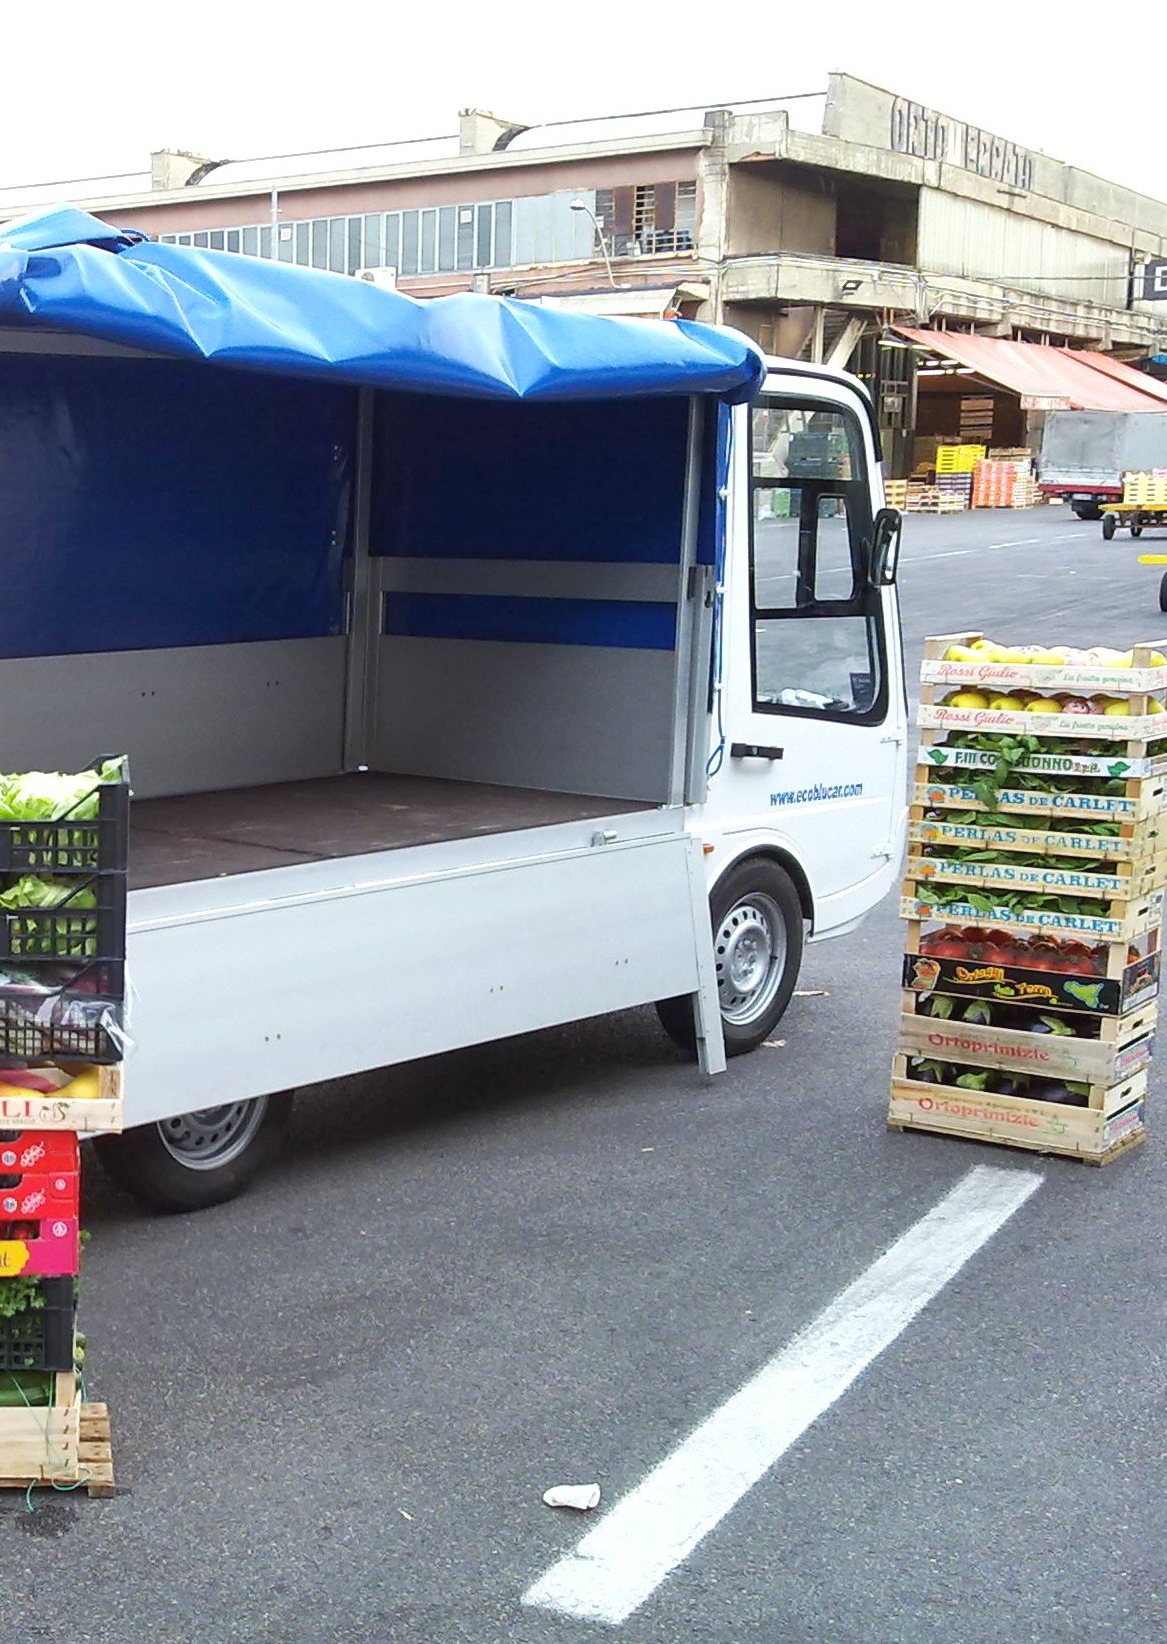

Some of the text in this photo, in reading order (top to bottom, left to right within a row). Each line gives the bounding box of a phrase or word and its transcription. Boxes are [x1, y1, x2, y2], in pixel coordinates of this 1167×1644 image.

[938, 664, 973, 677] Rossi
[979, 666, 1018, 680] Giulio
[935, 709, 970, 722] Rossi
[975, 711, 1014, 726] Giulio
[770, 782, 862, 806] www.ecoblucar.com
[942, 826, 1016, 843] PERLAS
[1045, 834, 1121, 852] CARLET
[940, 862, 1121, 890] PERLAS DE CARLET
[1038, 913, 1118, 933] CARLET
[928, 1033, 1050, 1061] Ortoprimizie
[918, 1097, 1040, 1128] Ortoprimizie
